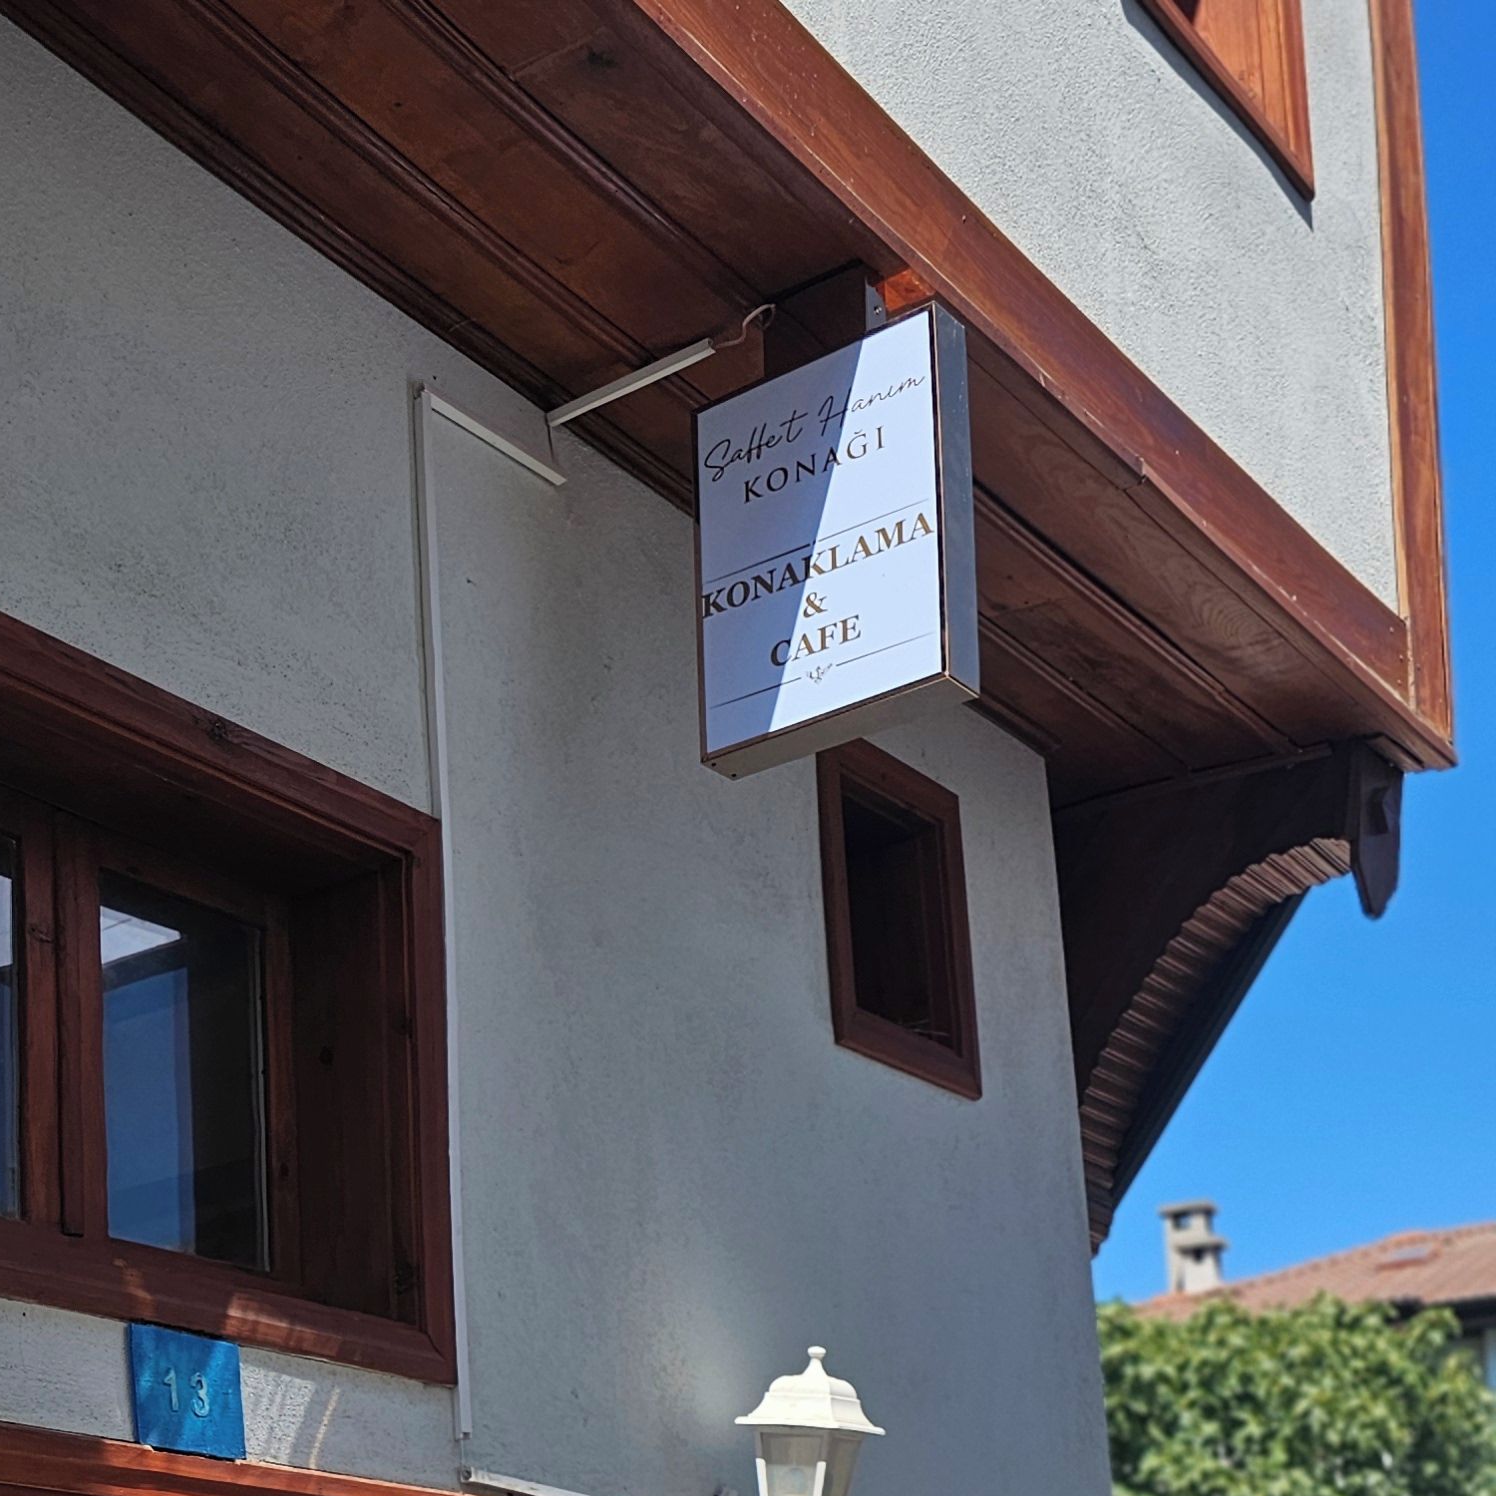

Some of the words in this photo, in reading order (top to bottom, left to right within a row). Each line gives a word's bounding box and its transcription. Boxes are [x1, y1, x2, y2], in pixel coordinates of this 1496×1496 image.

[703, 408, 808, 484] Saffet
[817, 375, 926, 438] Hanım
[743, 425, 886, 504] KONAĞI
[701, 511, 935, 619] KONAKLAMA
[802, 591, 829, 619] &
[769, 614, 862, 668] CAFE
[162, 1366, 210, 1418] 13
